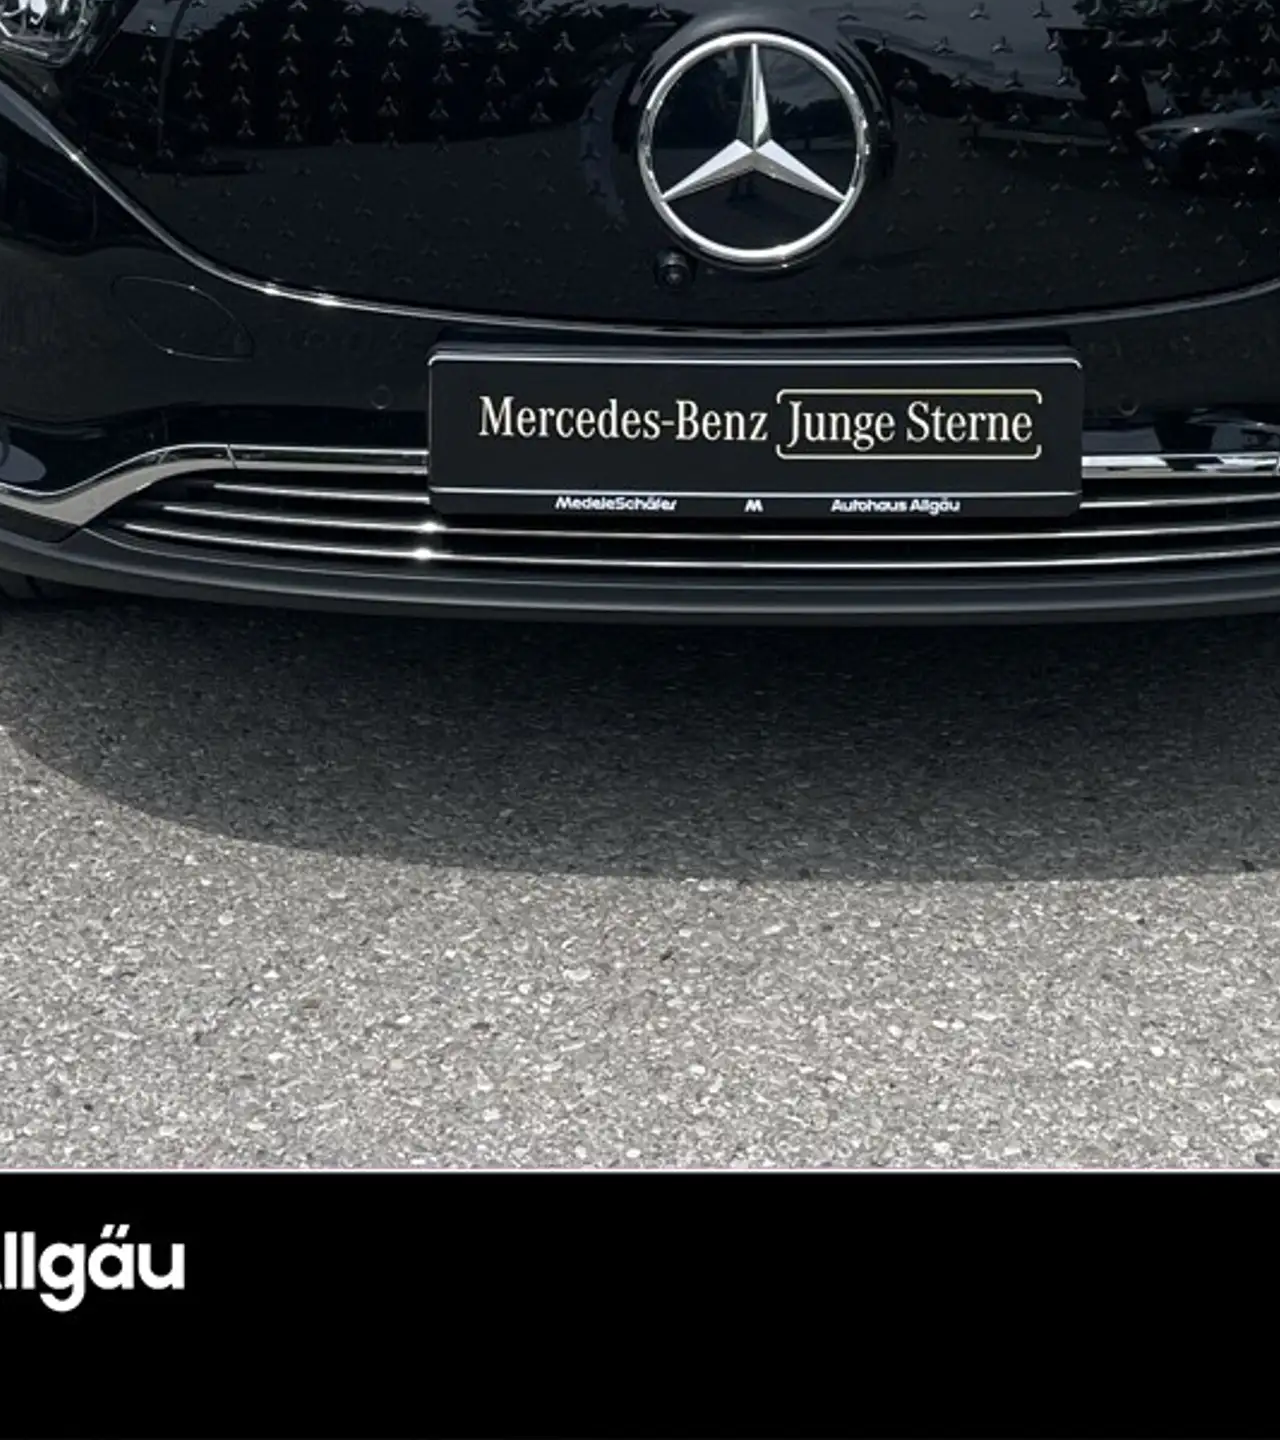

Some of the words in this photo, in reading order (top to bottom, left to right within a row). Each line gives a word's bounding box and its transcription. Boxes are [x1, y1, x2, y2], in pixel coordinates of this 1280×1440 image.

[478, 395, 768, 440] Mercedes-Benz
[786, 400, 896, 451] Junge
[906, 400, 1033, 443] Sterne
[831, 498, 907, 513] Autohaus
[909, 497, 961, 516] Allgäu
